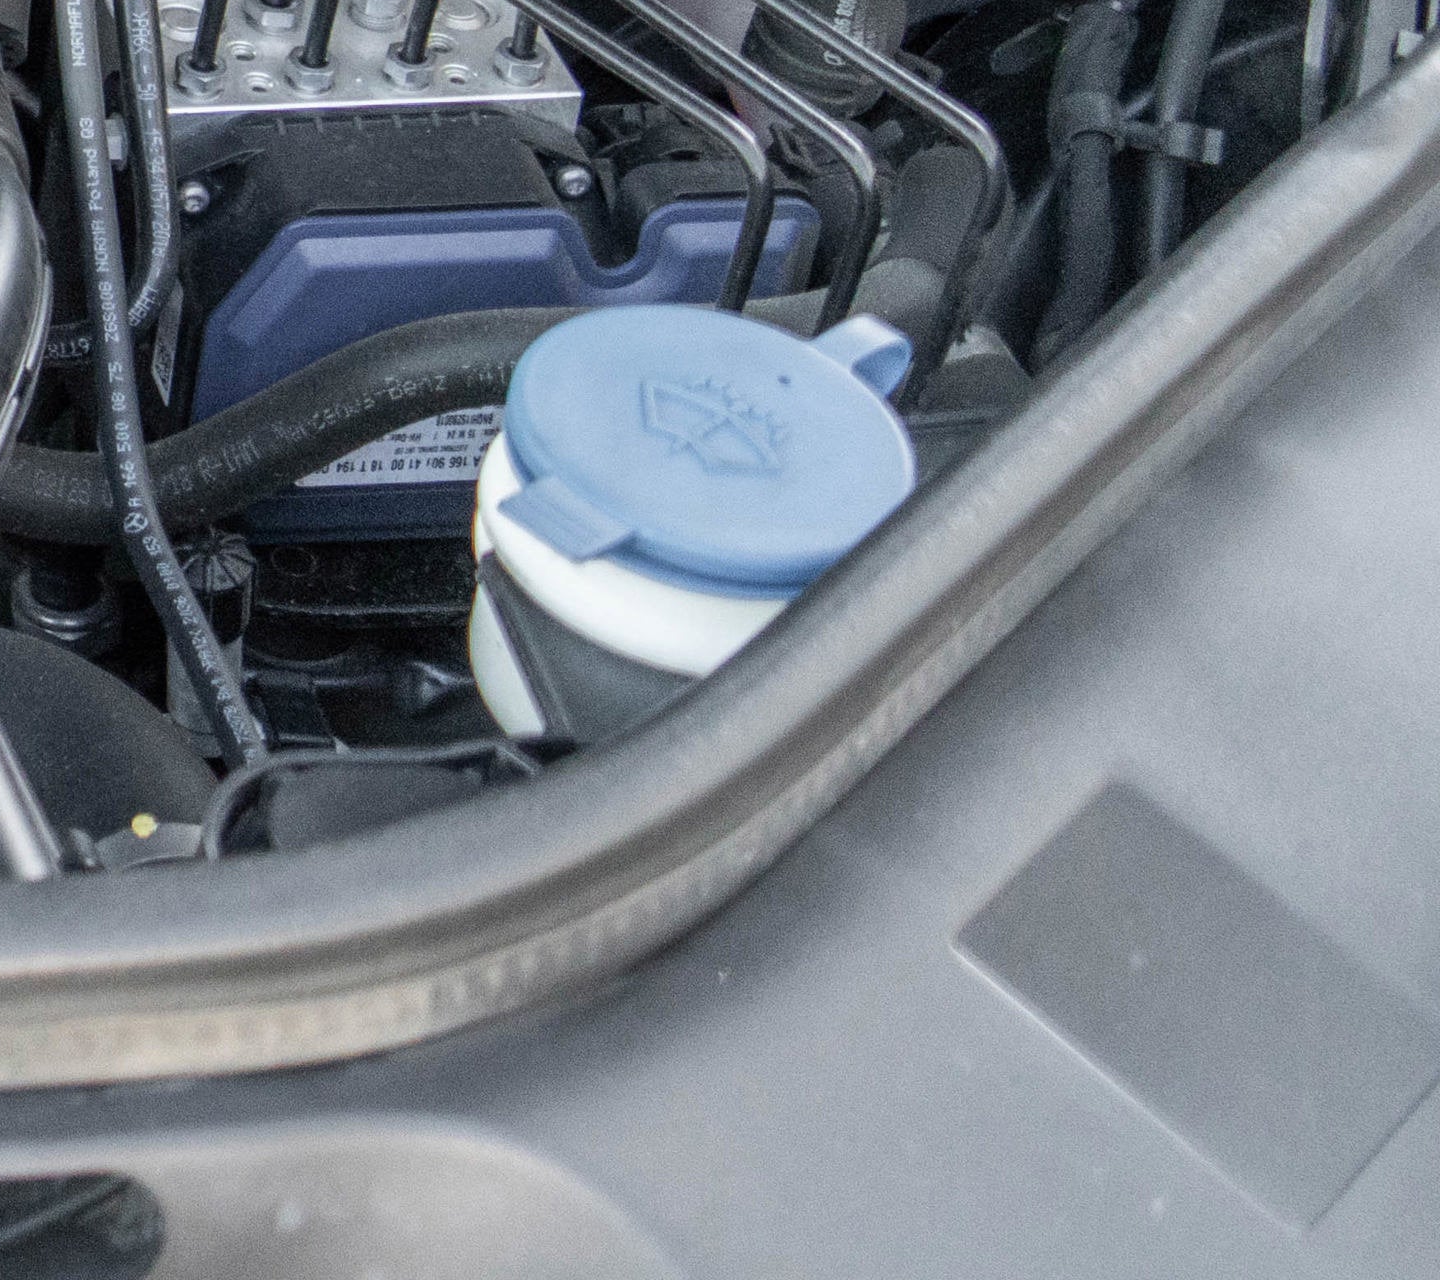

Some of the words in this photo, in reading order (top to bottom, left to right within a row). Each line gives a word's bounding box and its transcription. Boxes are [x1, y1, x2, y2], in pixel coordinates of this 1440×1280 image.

[82, 148, 102, 212] Poland
[92, 220, 110, 272] NORMA
[109, 361, 123, 383] 75
[112, 392, 126, 411] 08
[116, 422, 131, 452] 500
[360, 461, 367, 472] T
[390, 458, 404, 471] 00
[408, 457, 421, 470] 41
[449, 456, 467, 468] 166
[120, 460, 138, 487] 166
